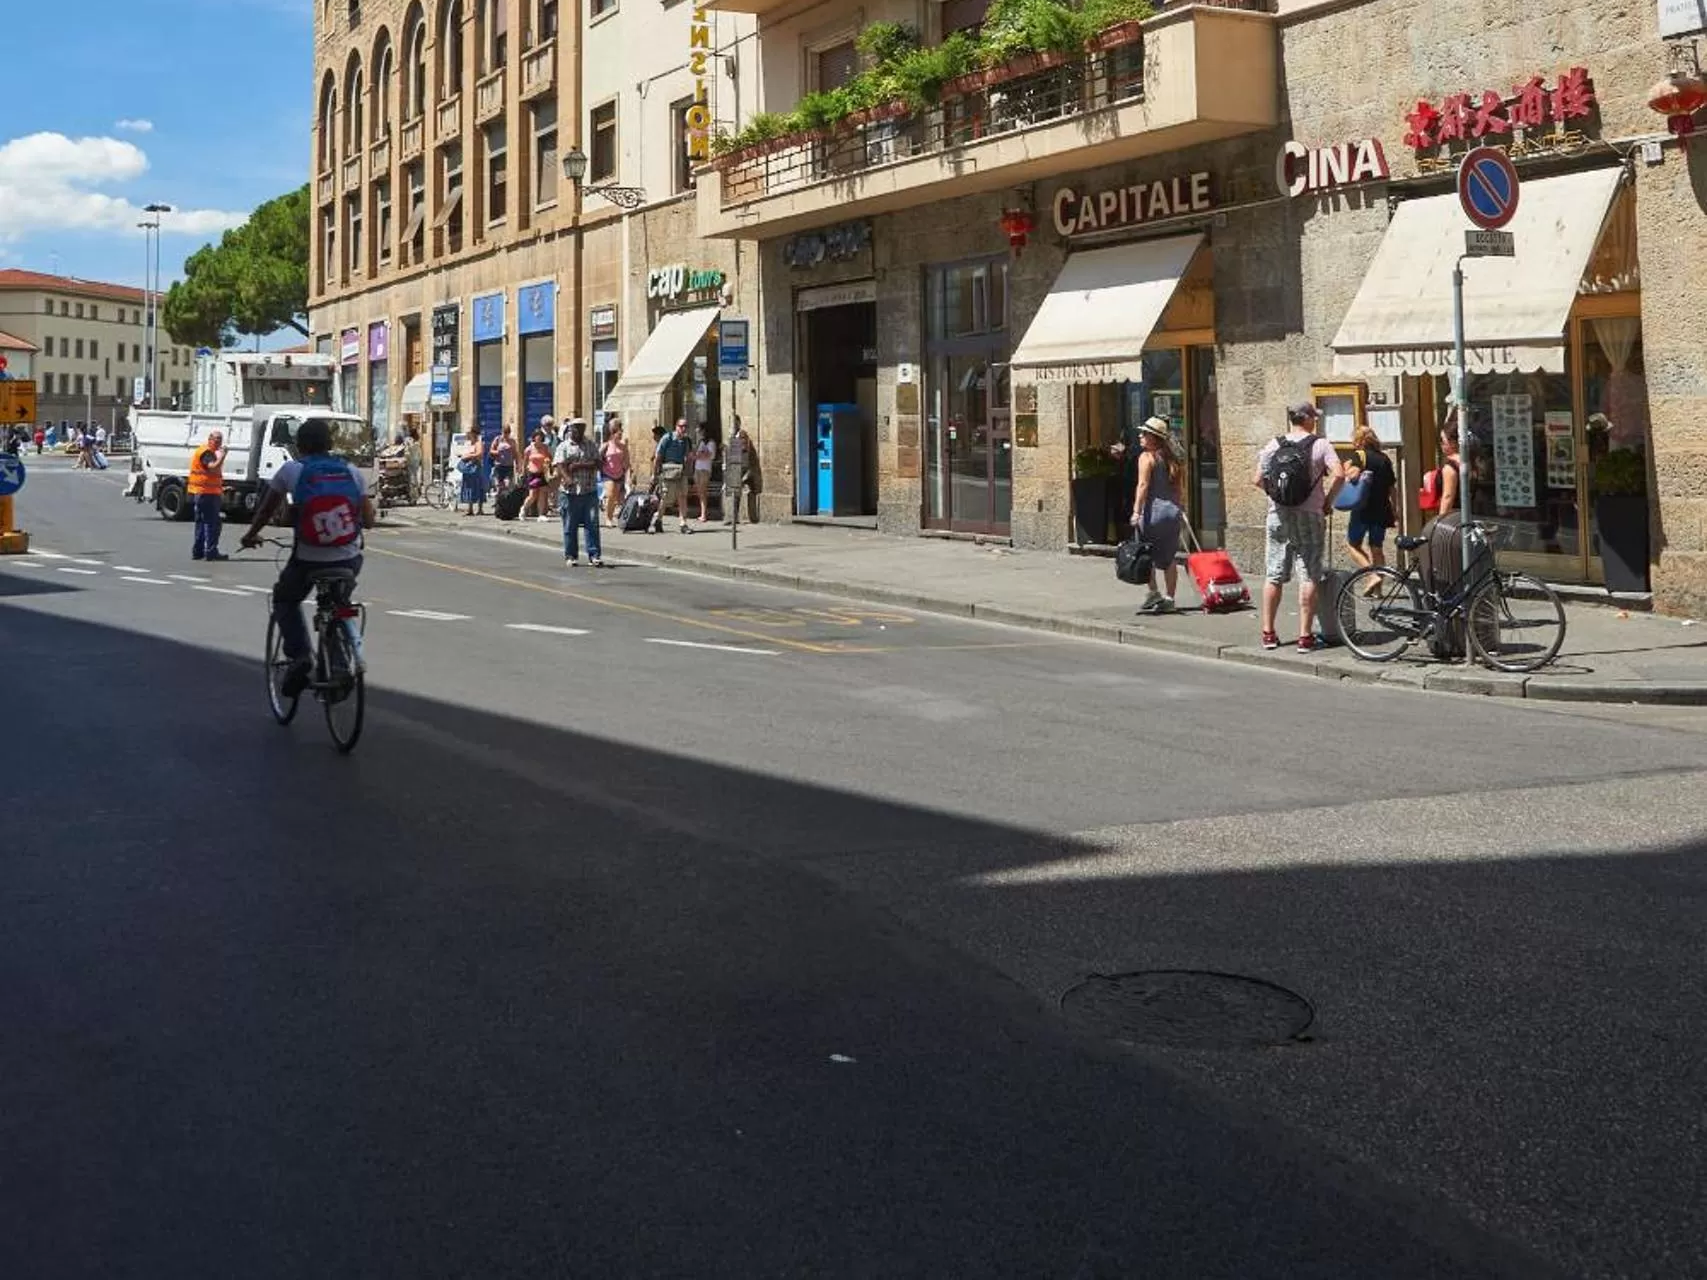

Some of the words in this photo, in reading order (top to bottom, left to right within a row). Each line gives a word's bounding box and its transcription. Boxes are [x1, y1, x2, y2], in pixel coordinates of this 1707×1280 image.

[1276, 137, 1390, 197] CINA
[1053, 171, 1210, 237] CAPITALE
[648, 265, 684, 299] cap
[1373, 344, 1517, 369] RISTORNTE
